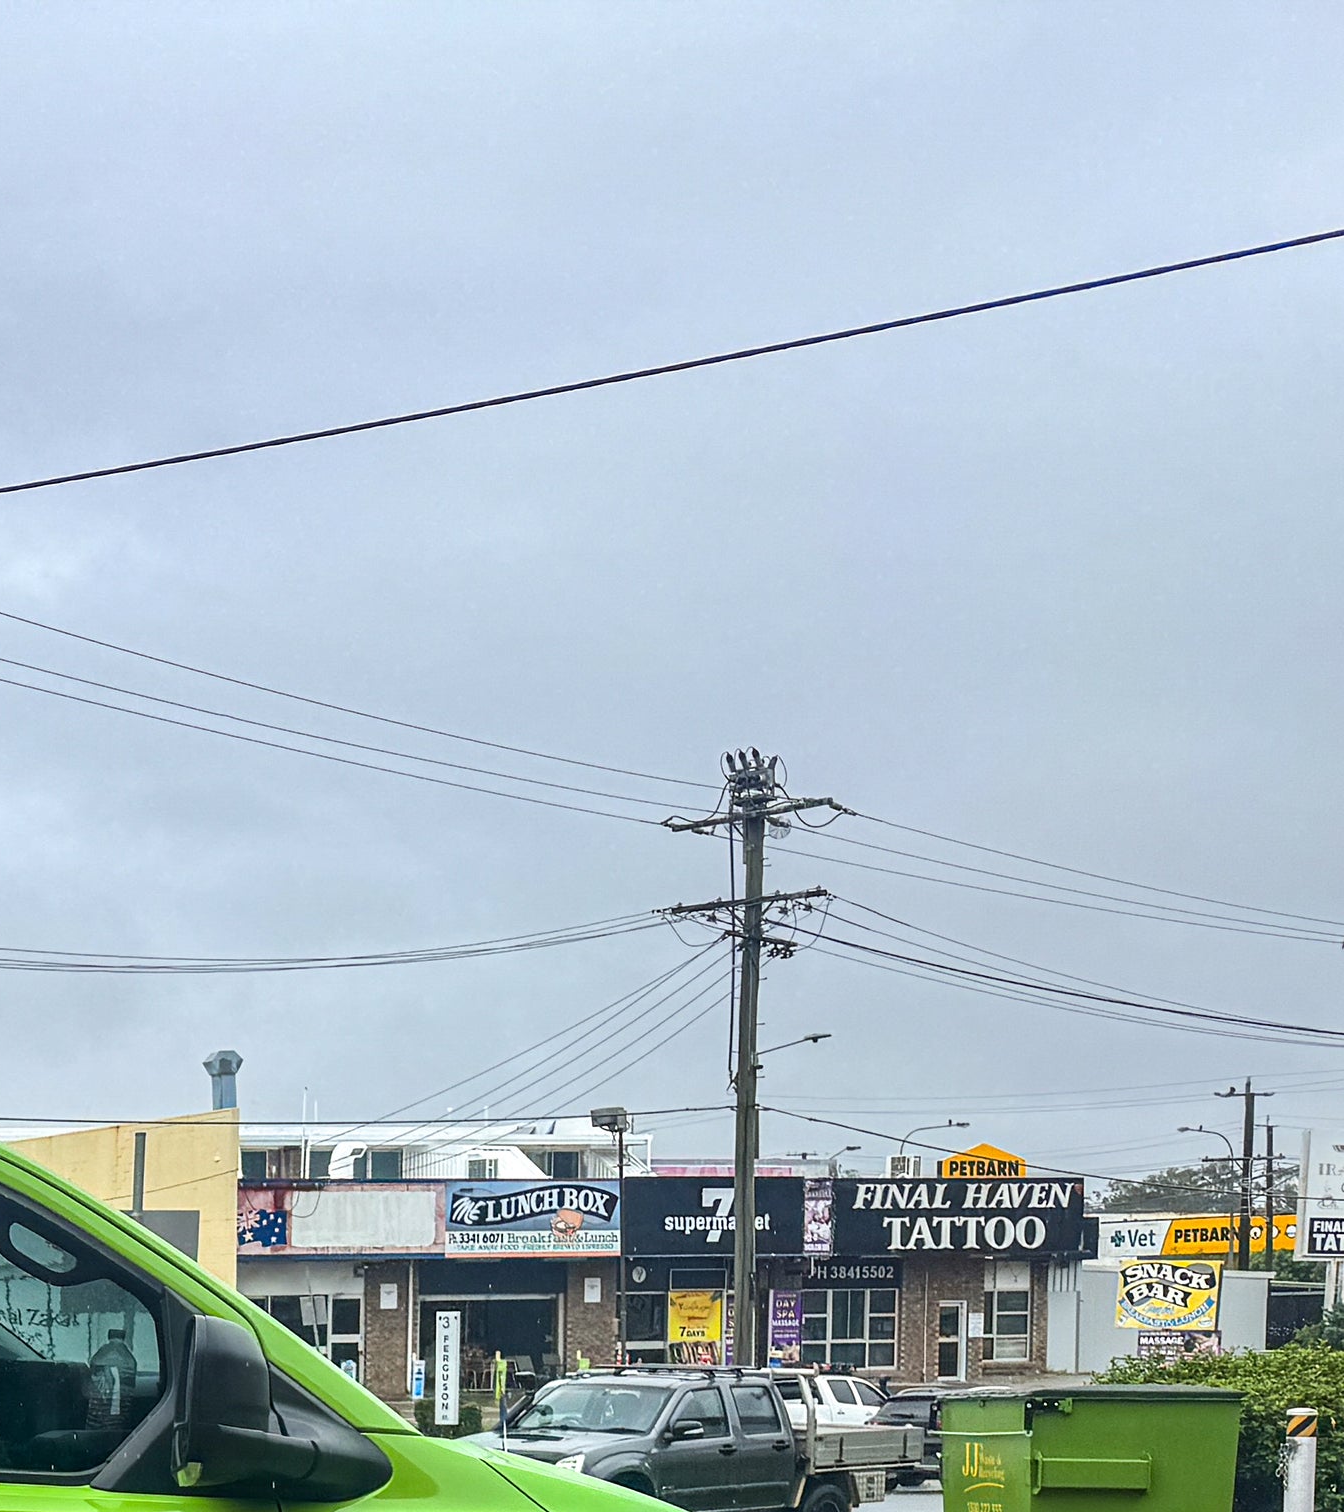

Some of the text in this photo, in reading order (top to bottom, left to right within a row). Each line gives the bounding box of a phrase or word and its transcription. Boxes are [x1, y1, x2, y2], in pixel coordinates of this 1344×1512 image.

[949, 1160, 1020, 1177] PETBARN
[852, 1183, 952, 1209] FINAL
[962, 1182, 1075, 1209] HAVEN
[485, 1188, 560, 1222] LUNCH
[563, 1188, 610, 1217] BOX
[664, 1213, 770, 1235] supermaet
[702, 1188, 735, 1243] 7
[459, 1233, 480, 1244] 3341
[482, 1233, 504, 1244] 6071
[882, 1216, 1046, 1250] TATTOO
[1128, 1229, 1156, 1247] Vet
[830, 1265, 894, 1279] 38415502
[1125, 1263, 1211, 1289] SNACK
[1129, 1282, 1186, 1306] BAR
[776, 1300, 796, 1308] DAY
[442, 1316, 450, 1329] 3
[776, 1310, 795, 1319] SPA
[679, 1326, 686, 1337] 7
[1139, 1336, 1184, 1345] MASSAGE
[441, 1335, 450, 1411] FERGUSON
